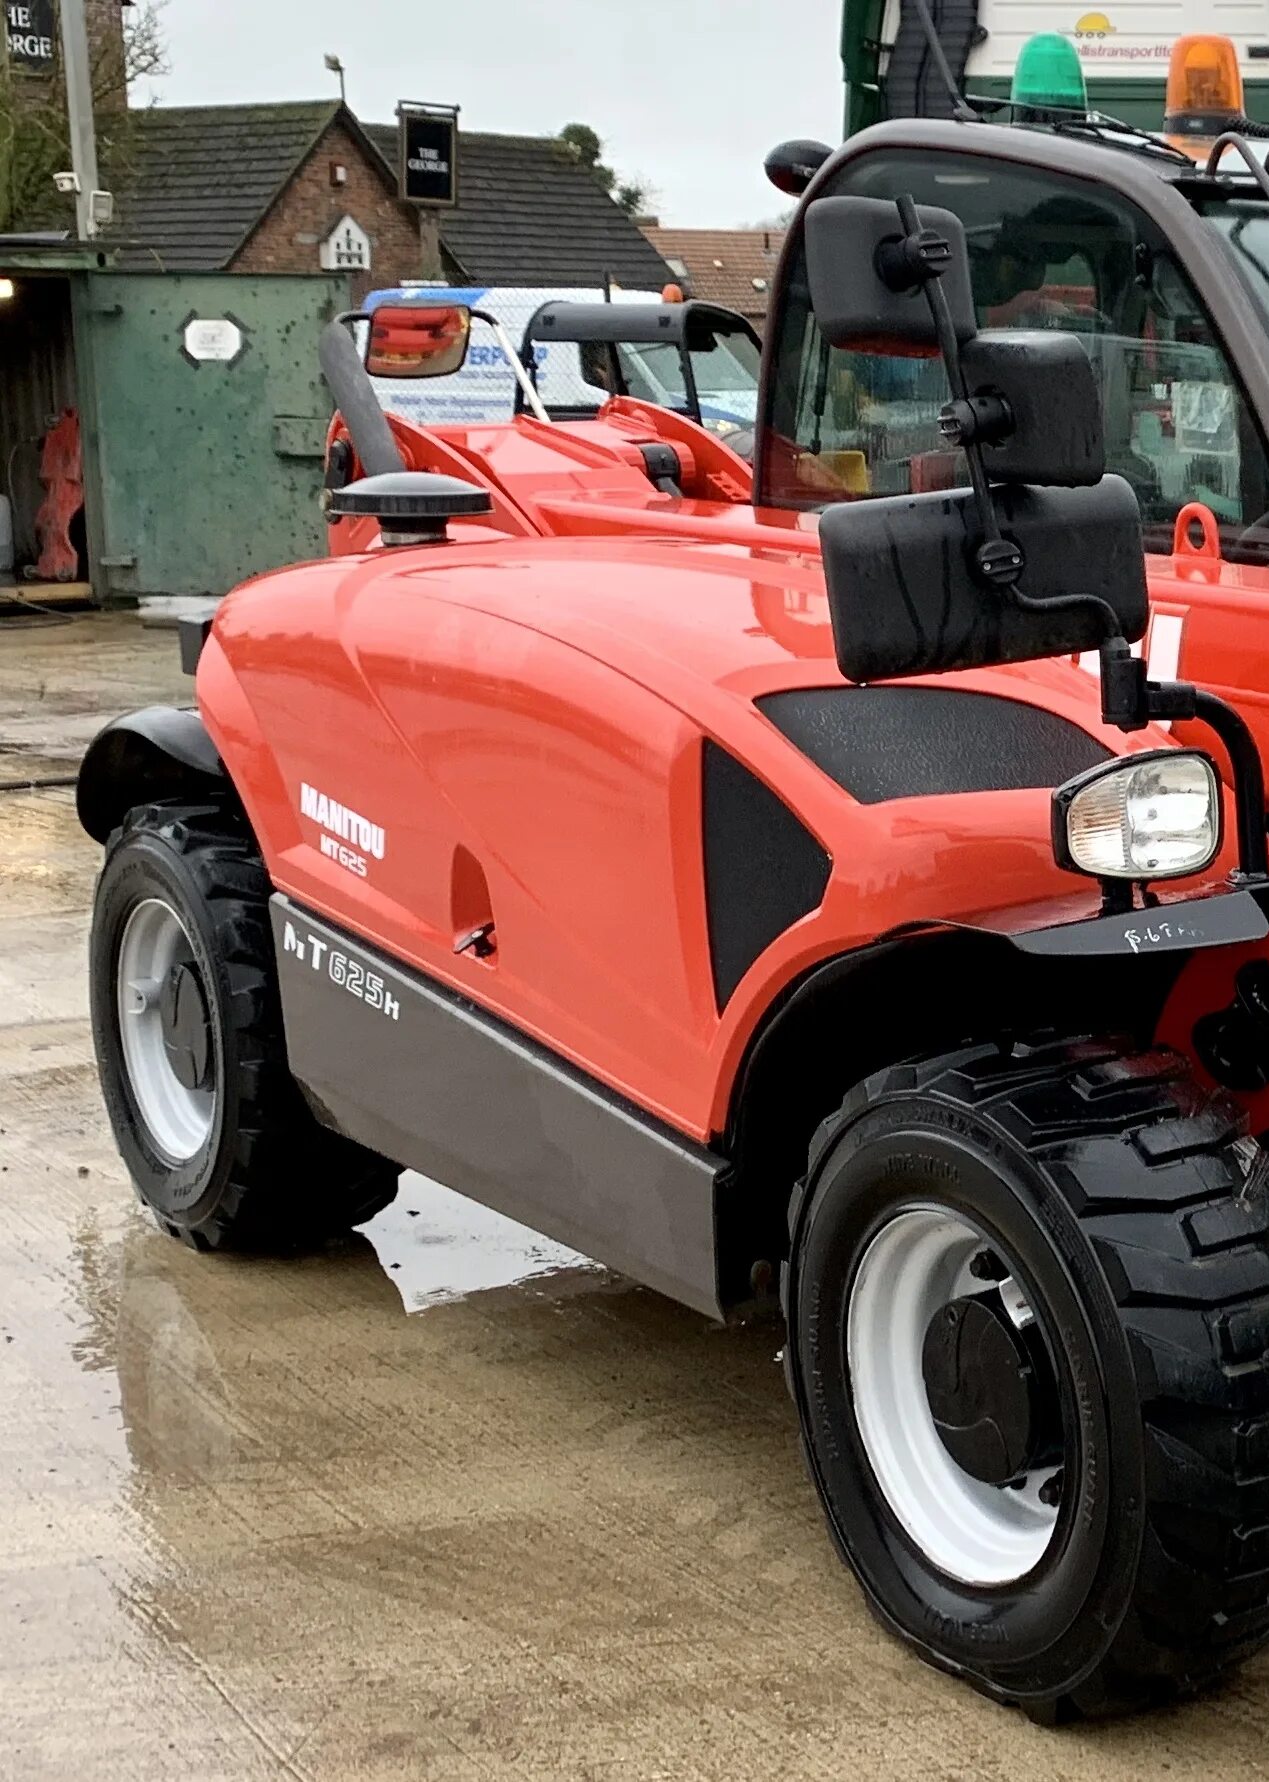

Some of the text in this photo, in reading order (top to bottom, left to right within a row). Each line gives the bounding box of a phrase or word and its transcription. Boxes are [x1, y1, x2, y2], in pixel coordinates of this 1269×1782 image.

[8, 6, 31, 27] HE
[8, 34, 53, 58] RGE
[301, 781, 385, 860] MANITOU
